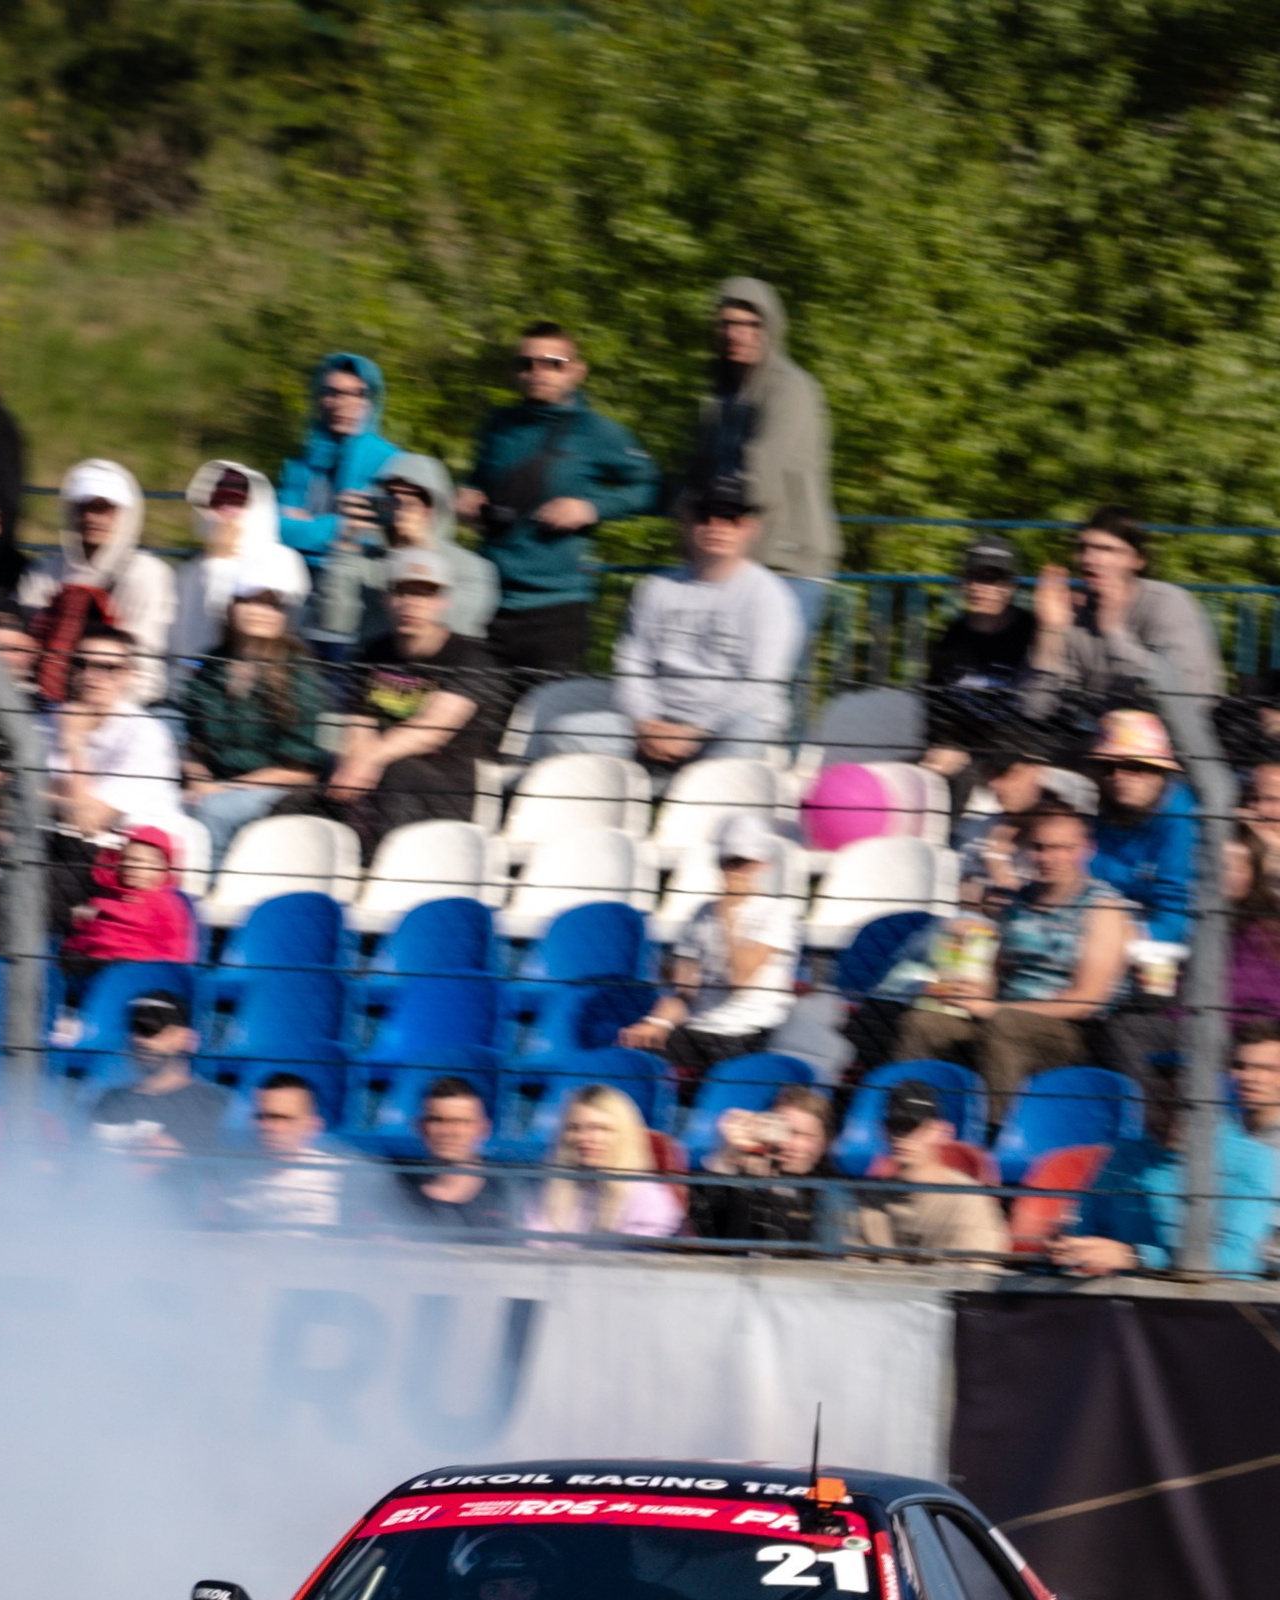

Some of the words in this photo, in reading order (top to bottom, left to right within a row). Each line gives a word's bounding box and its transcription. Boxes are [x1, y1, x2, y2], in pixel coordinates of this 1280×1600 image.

[410, 1474, 554, 1490] LUKOIL
[566, 1475, 728, 1491] RACING
[509, 1500, 607, 1517] RDS
[637, 1505, 719, 1518] EUROPE
[731, 1509, 800, 1531] PR
[756, 1545, 870, 1594] 21
